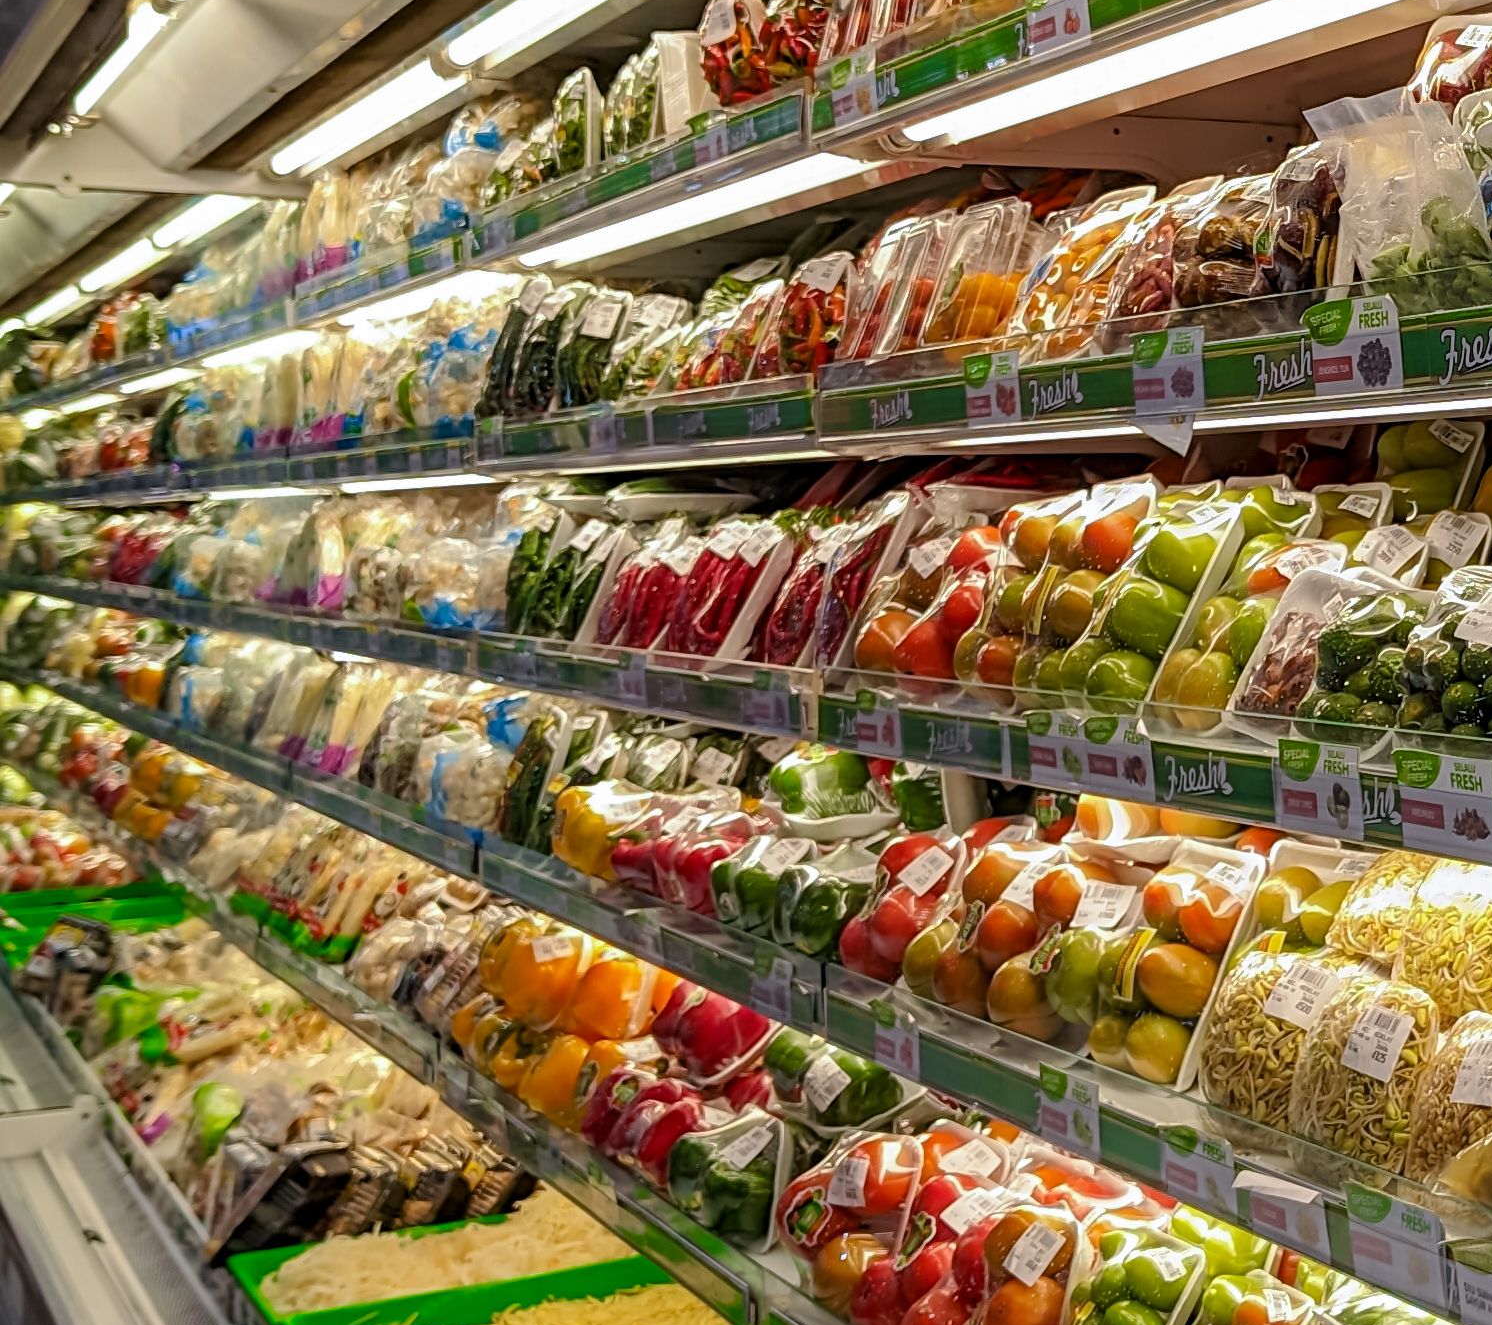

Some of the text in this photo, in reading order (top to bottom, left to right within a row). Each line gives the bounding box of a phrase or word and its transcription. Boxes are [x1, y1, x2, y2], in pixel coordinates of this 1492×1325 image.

[1310, 309, 1342, 328] SPECIAL
[1358, 311, 1389, 330] FRESH
[1253, 338, 1313, 402] Fresh
[1029, 367, 1071, 412] Fresh
[1323, 760, 1350, 777] FRESH
[1401, 759, 1433, 772] SPECIAL
[1163, 752, 1222, 802] Fresh
[1450, 773, 1483, 793] FRESH
[1400, 1212, 1432, 1236] FRESH
